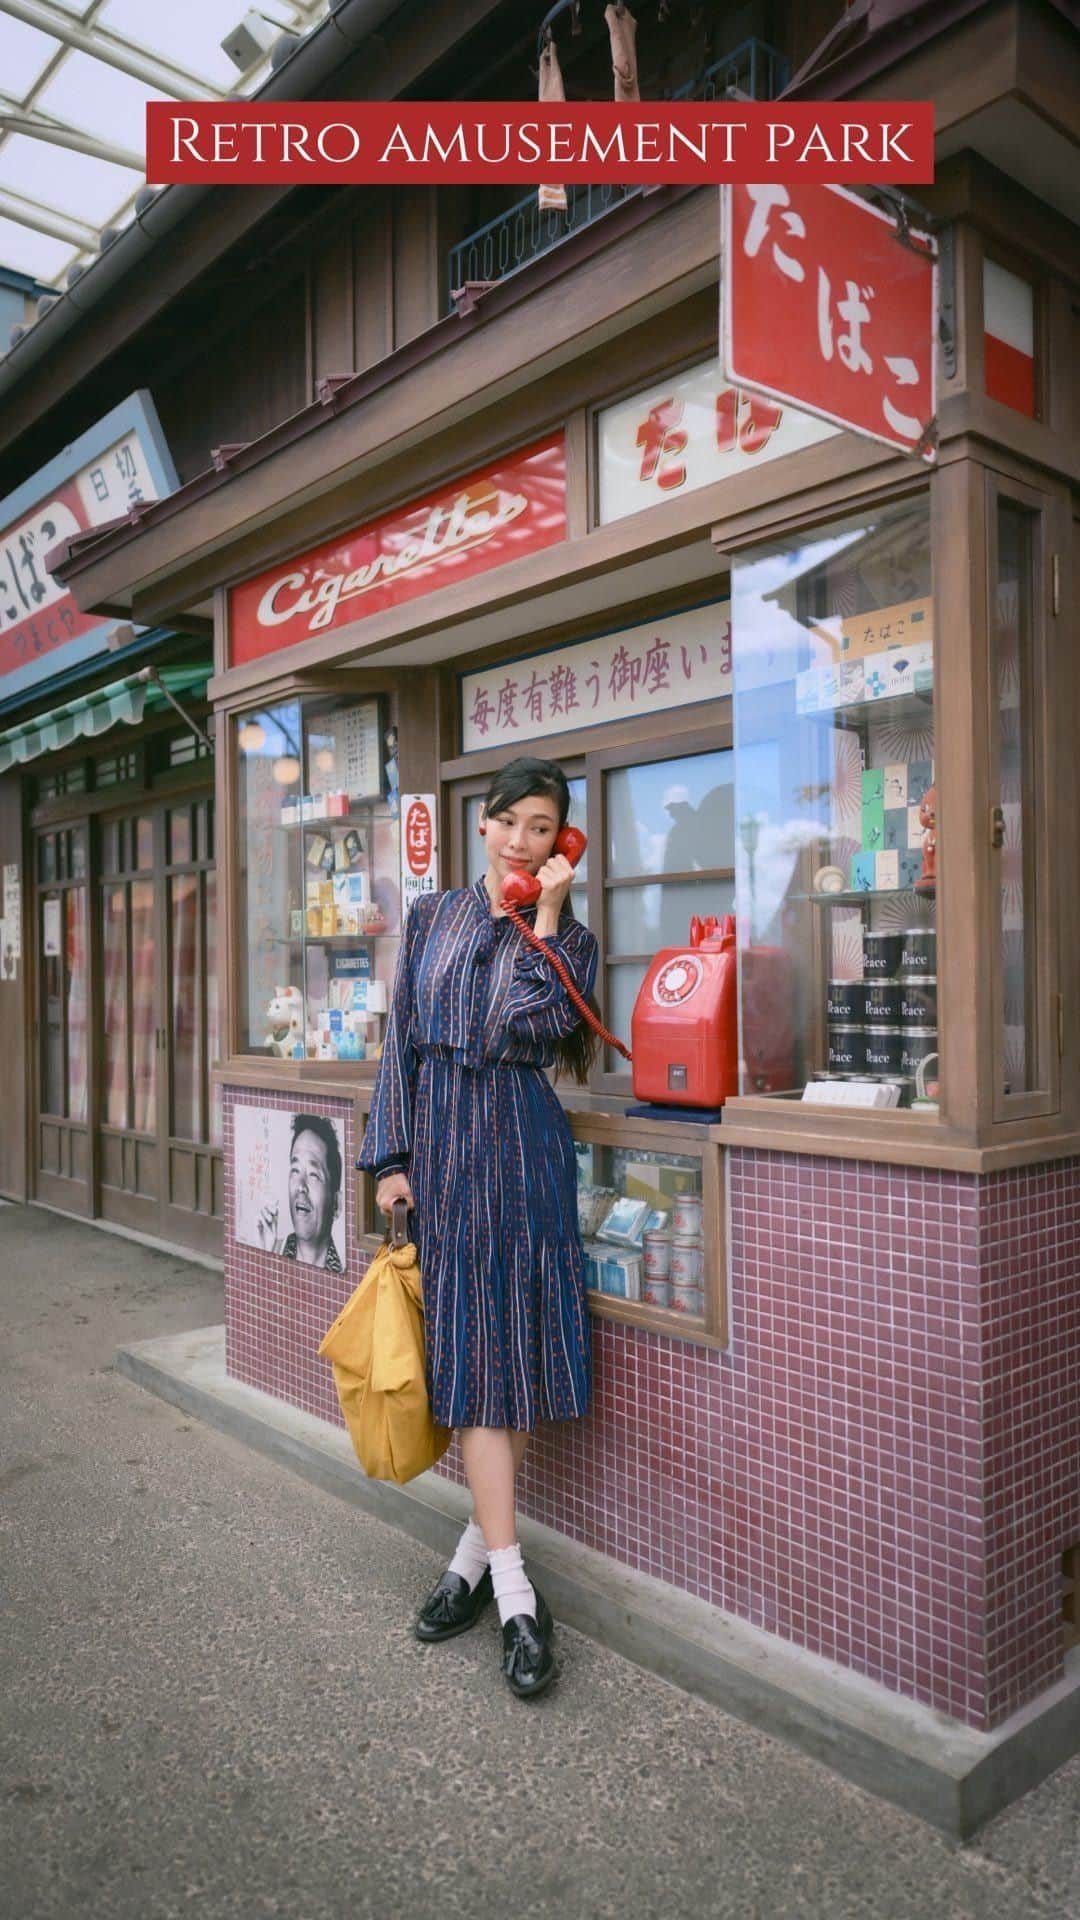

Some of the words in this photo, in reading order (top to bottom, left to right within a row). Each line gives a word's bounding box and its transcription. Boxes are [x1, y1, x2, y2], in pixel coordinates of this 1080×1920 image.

[744, 184, 923, 440] たばこ
[256, 492, 528, 631] Cigarettes
[409, 807, 429, 869] たばこ
[902, 951, 928, 966] Peace
[827, 1000, 851, 1015] Peace
[865, 1000, 891, 1016] Peace
[901, 1001, 926, 1017] Peace
[829, 1048, 853, 1063] Peace
[866, 1048, 890, 1064] Peace
